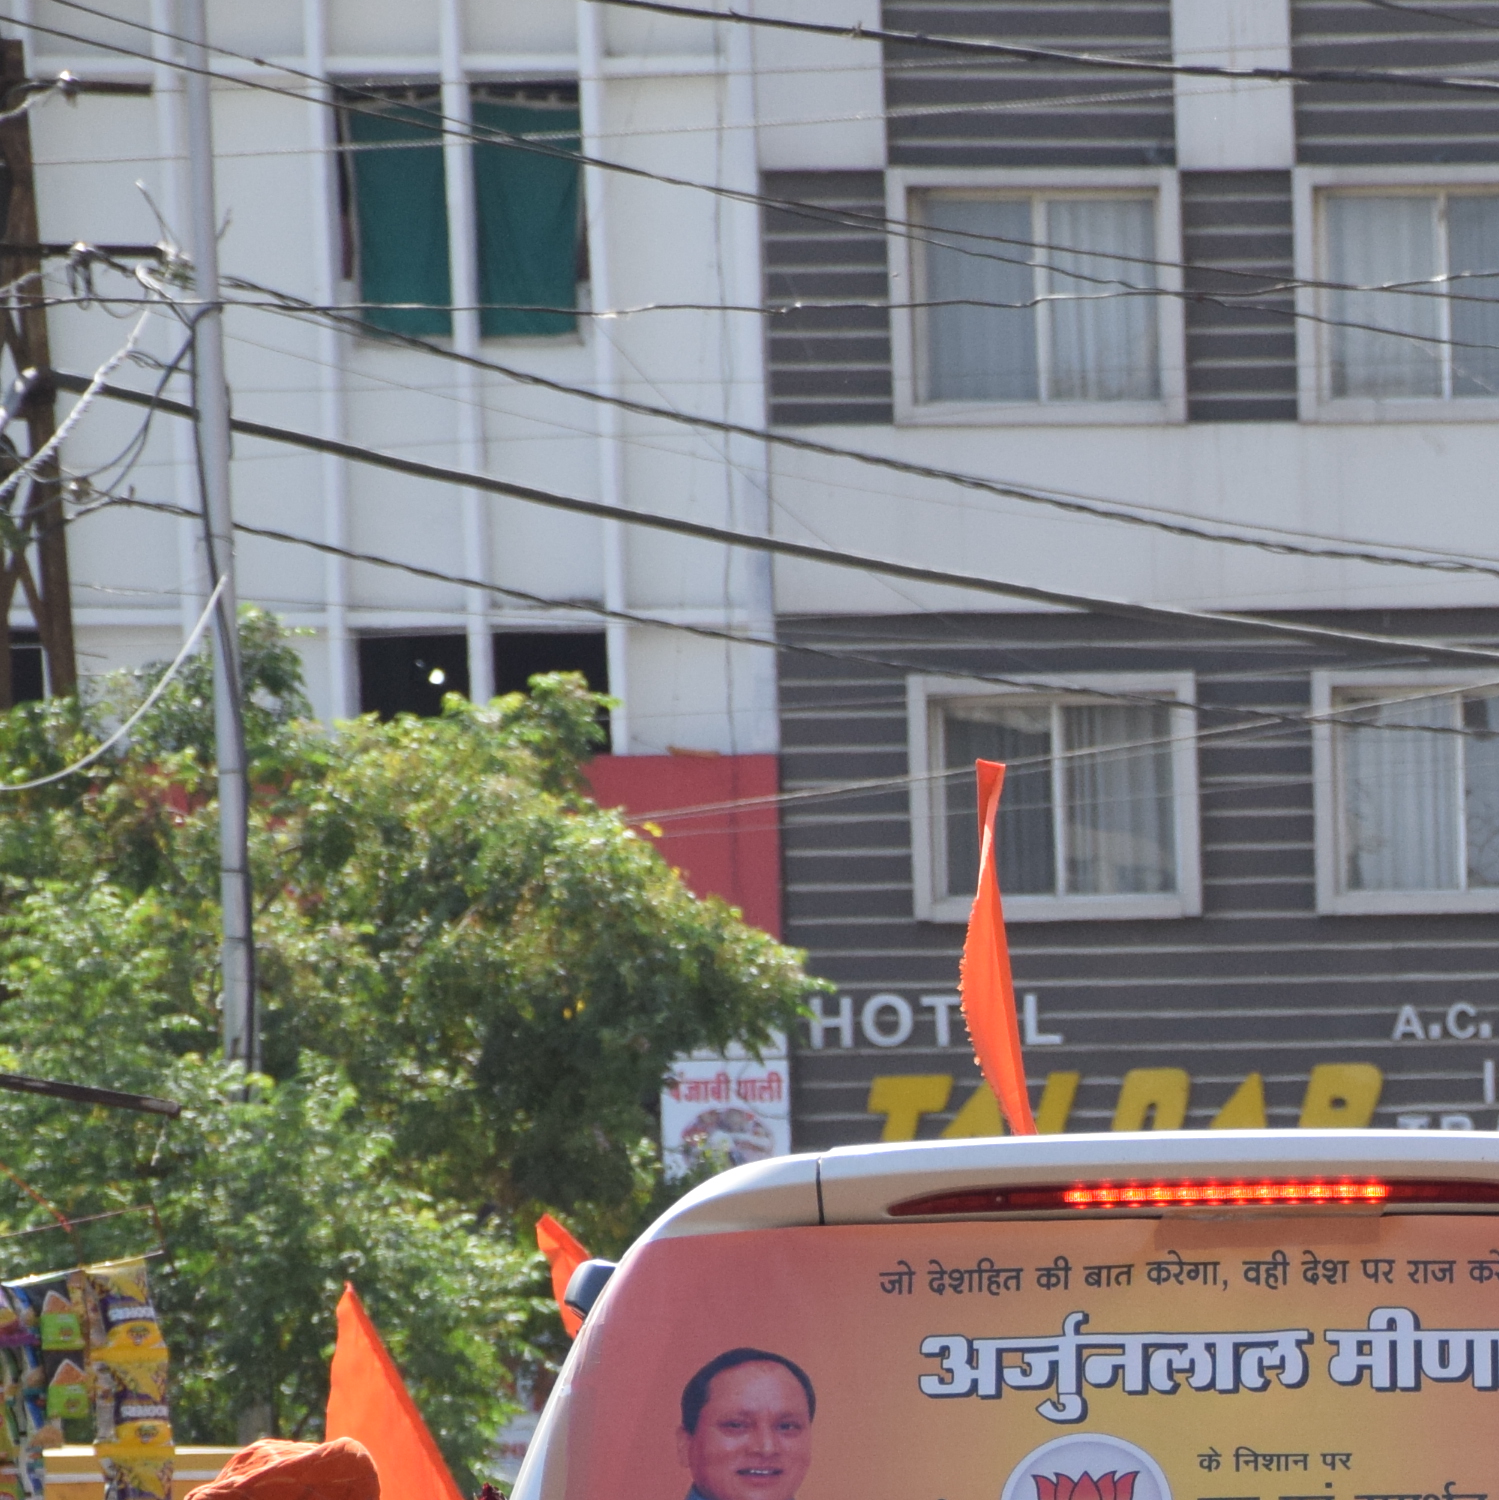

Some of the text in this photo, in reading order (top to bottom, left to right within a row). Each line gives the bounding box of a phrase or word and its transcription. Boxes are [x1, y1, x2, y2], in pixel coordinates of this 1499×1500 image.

[808, 991, 1064, 1050] HOTL
[878, 1260, 917, 1295] जो
[927, 1257, 1024, 1297] देशहित
[1035, 1255, 1073, 1291] की
[1083, 1262, 1135, 1288] बात
[1241, 1249, 1290, 1290] वही
[1301, 1249, 1350, 1286] देश
[1360, 1259, 1396, 1285] पर
[1406, 1259, 1457, 1285] राज
[917, 1311, 1310, 1425] अर्जुनलाल
[1197, 1445, 1353, 1473] के निशान पर
